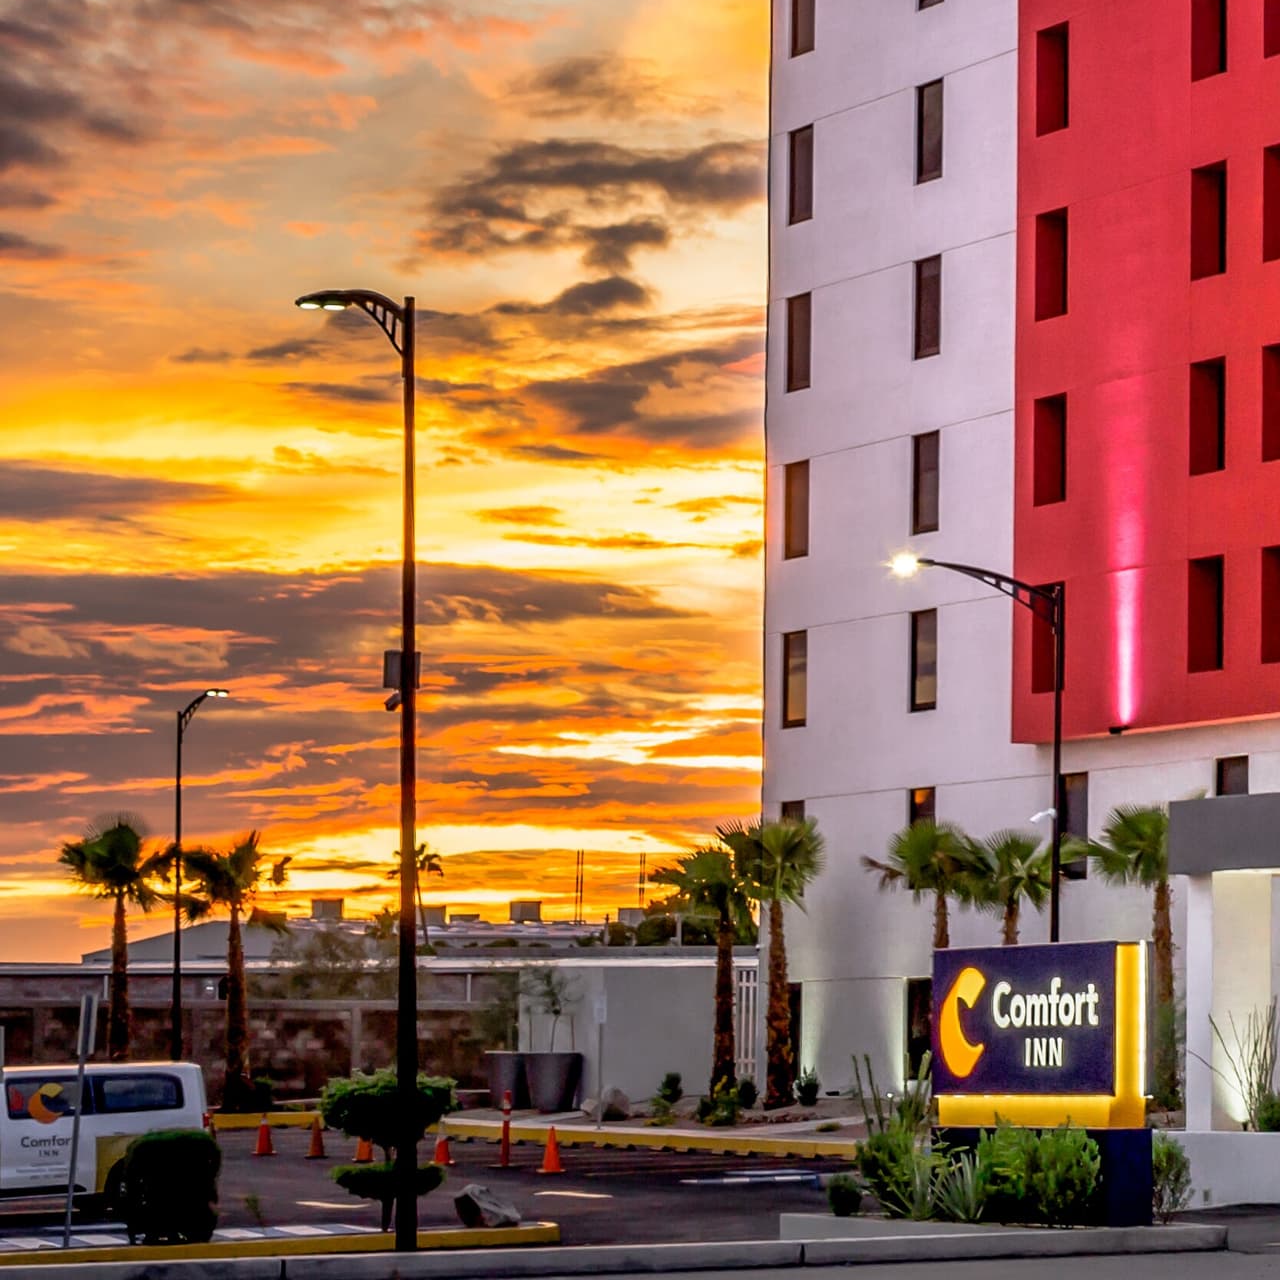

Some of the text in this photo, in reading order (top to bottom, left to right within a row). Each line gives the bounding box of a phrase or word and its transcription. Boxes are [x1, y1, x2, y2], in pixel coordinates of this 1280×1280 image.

[992, 976, 1099, 1029] Comfort
[1024, 1037, 1063, 1067] INN
[21, 1134, 73, 1148] Comfor
